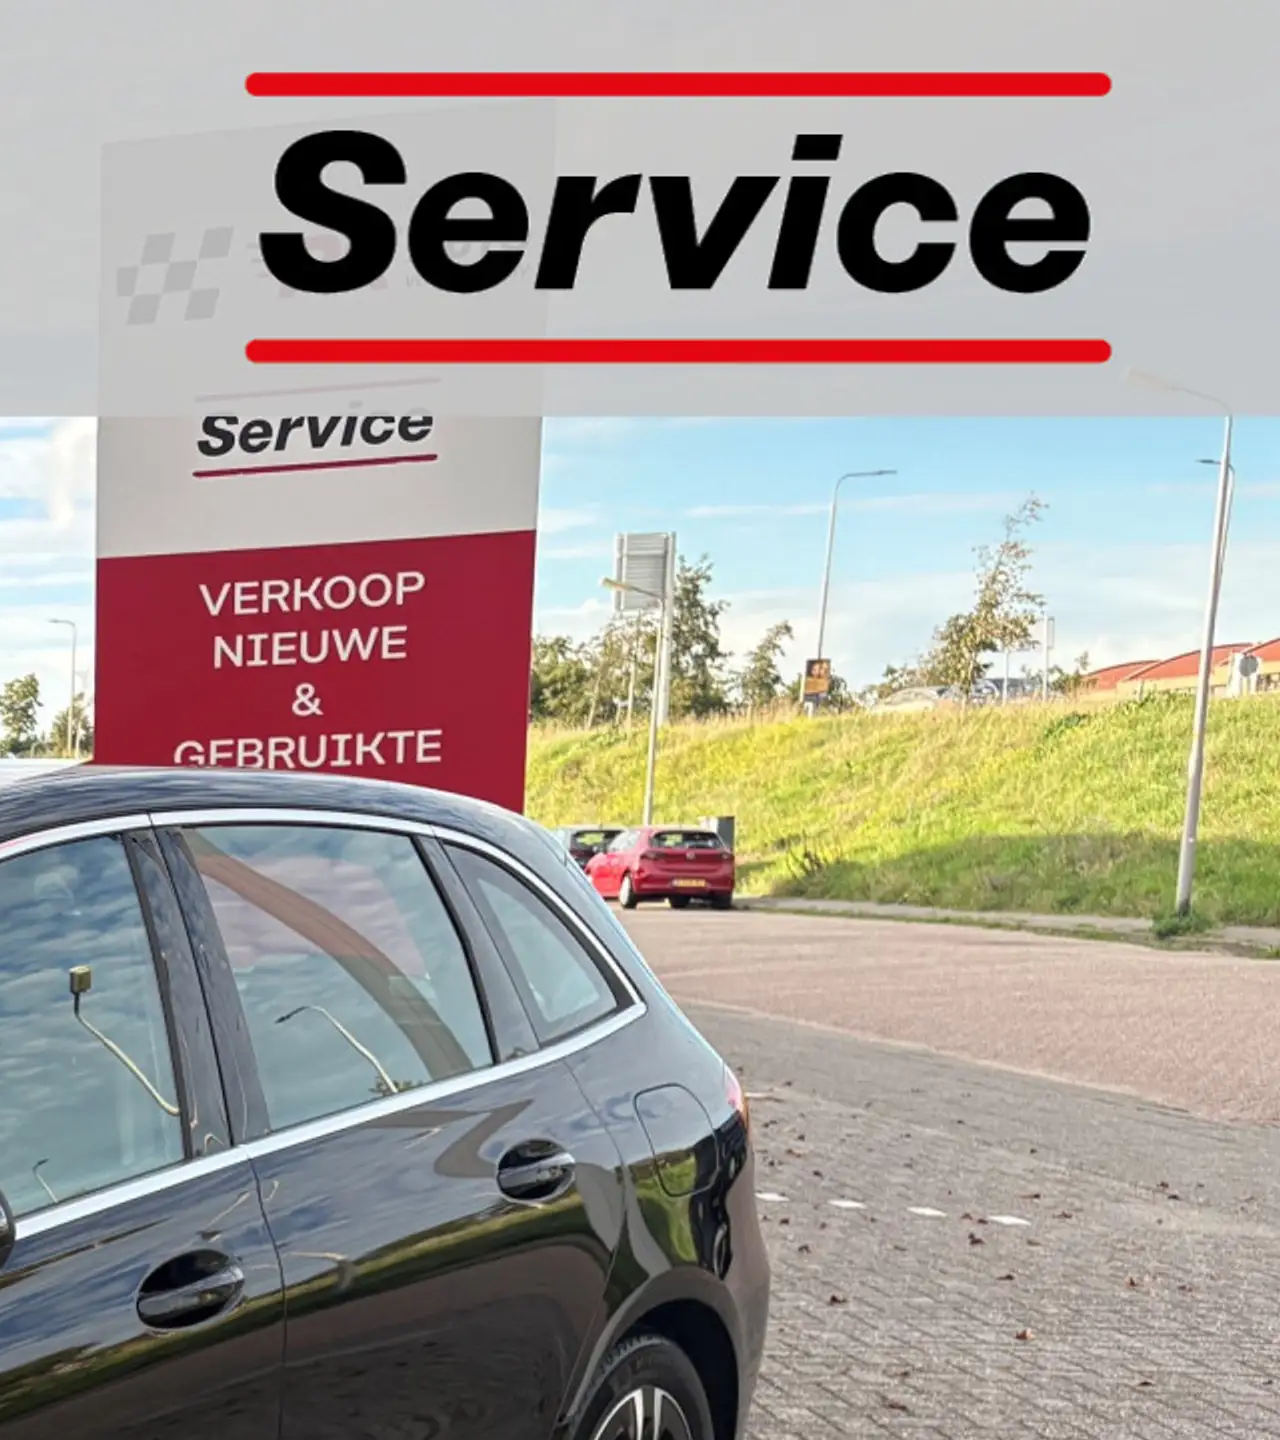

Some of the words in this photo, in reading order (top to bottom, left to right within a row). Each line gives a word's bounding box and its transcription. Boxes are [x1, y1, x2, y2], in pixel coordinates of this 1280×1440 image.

[197, 405, 434, 457] Service
[199, 571, 426, 616] VERKOOP
[213, 625, 408, 669] NIEUWE
[291, 683, 324, 716] &
[174, 729, 443, 769] GEBRUIKTE
